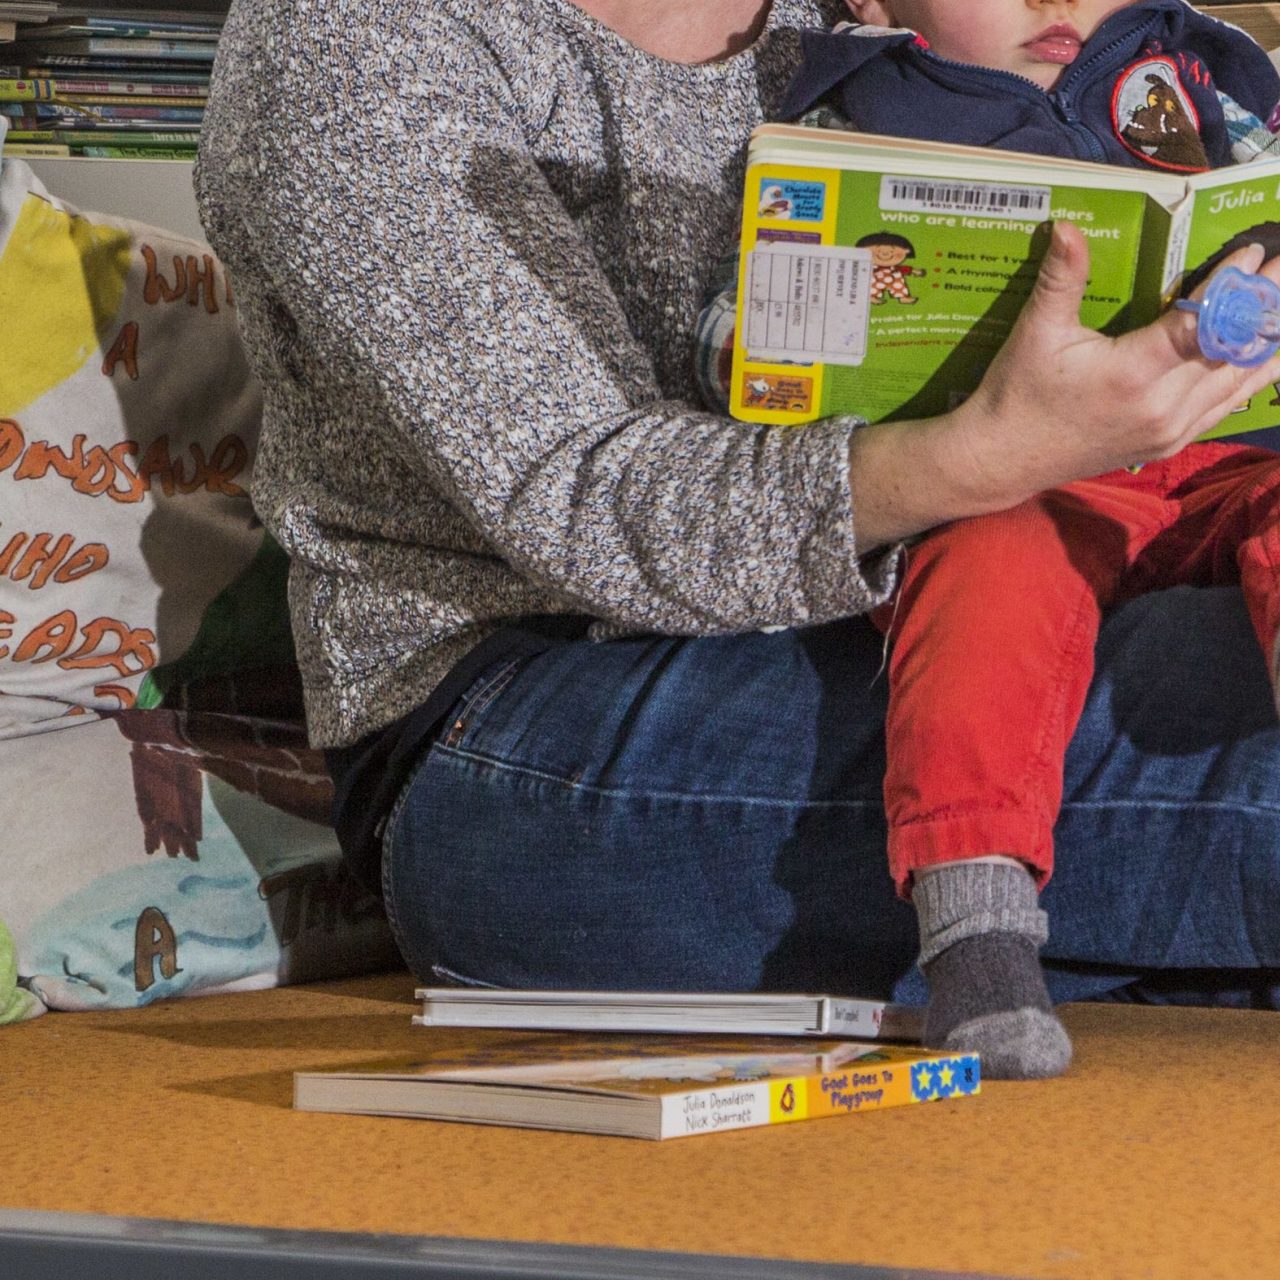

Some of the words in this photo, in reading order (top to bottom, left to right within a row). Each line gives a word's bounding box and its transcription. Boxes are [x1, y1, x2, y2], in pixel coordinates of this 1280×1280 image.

[1051, 208, 1094, 222] dlers
[1209, 193, 1264, 215] Julia
[881, 211, 920, 225] who
[925, 216, 956, 228] are
[962, 217, 1036, 234] learning
[1082, 227, 1121, 240] ount
[947, 251, 977, 262] Best
[980, 252, 1000, 263] for
[946, 266, 957, 275] A
[945, 282, 971, 293] Bold
[927, 312, 950, 321] Julia
[101, 320, 140, 380] A
[134, 906, 183, 992] A
[821, 1076, 849, 1092] Goat
[852, 1073, 878, 1088] Goes
[882, 1070, 893, 1083] To
[683, 1096, 706, 1114] Julia
[709, 1092, 756, 1110] Donaldson
[831, 1089, 883, 1111] Playgroup
[685, 1115, 709, 1131] Nick
[712, 1110, 752, 1128] Sharratt
